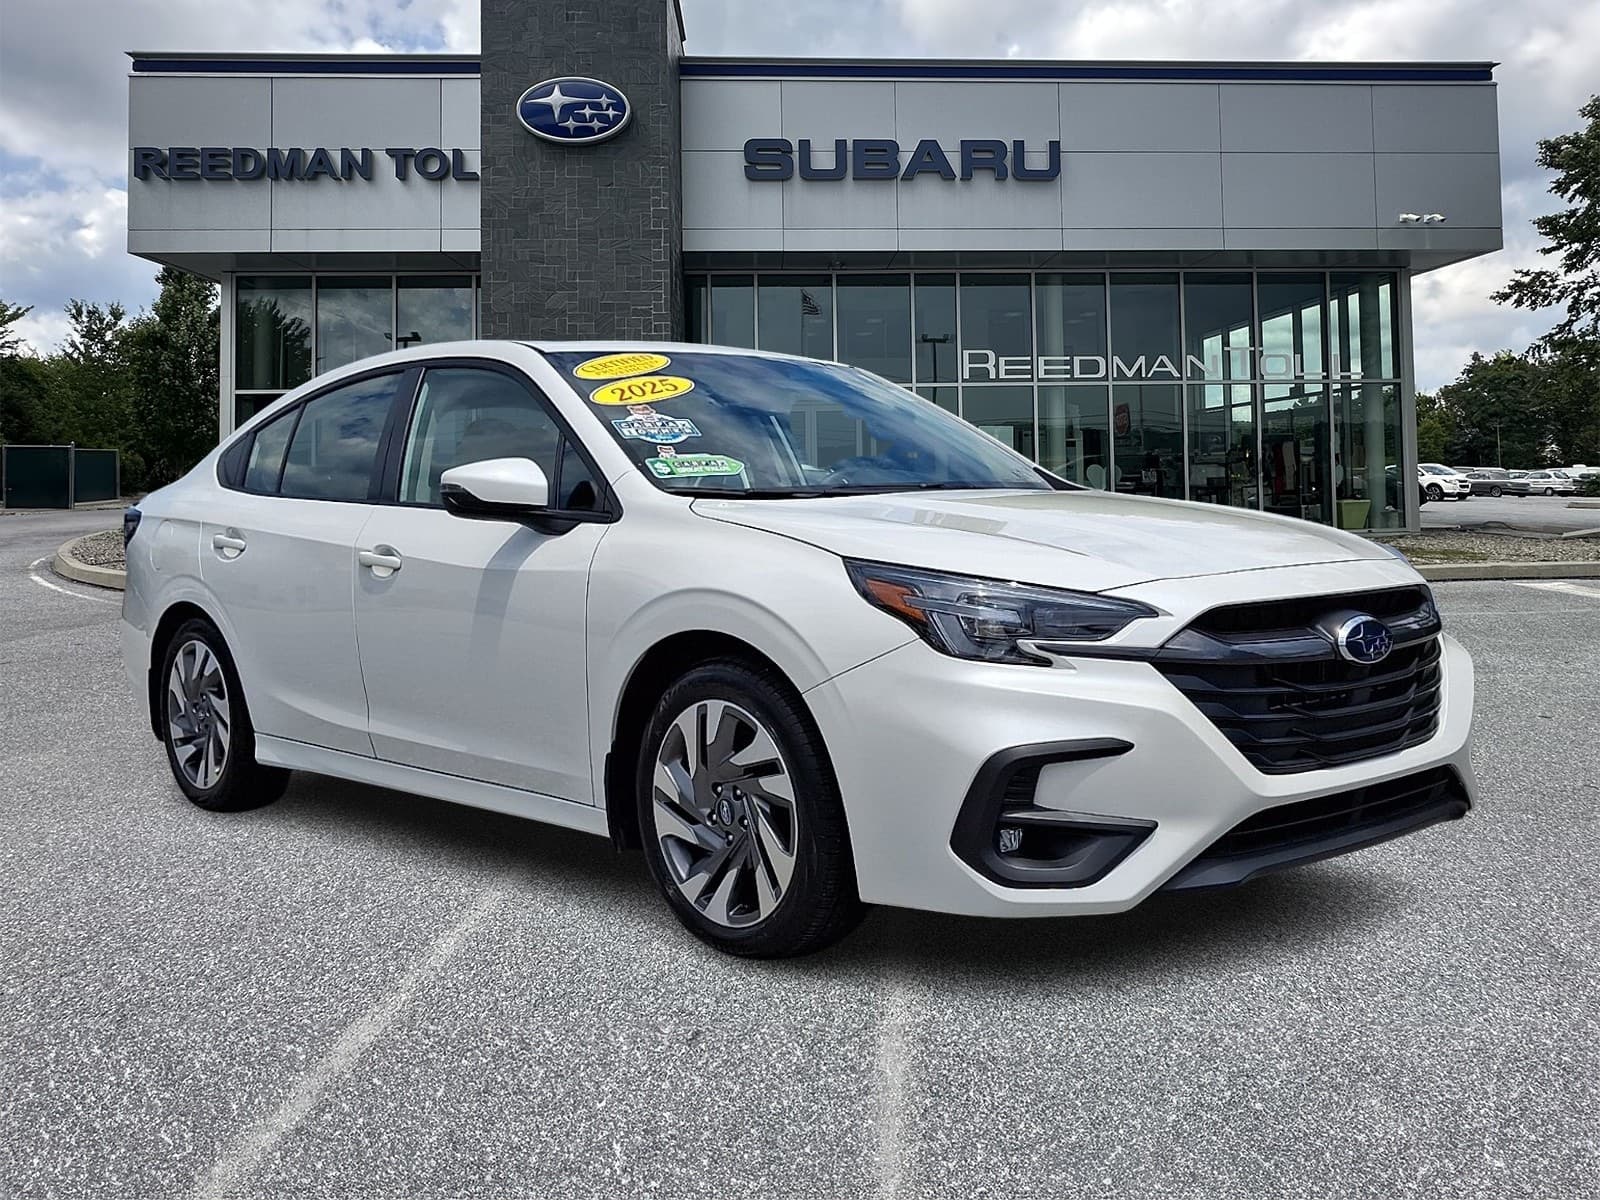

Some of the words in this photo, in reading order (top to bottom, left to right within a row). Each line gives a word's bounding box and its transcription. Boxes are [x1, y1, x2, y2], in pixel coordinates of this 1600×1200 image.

[133, 147, 373, 181] REEDMAN
[743, 137, 1061, 181] SUBARU
[962, 349, 1219, 380] REEDMAN
[610, 379, 679, 401] 2025
